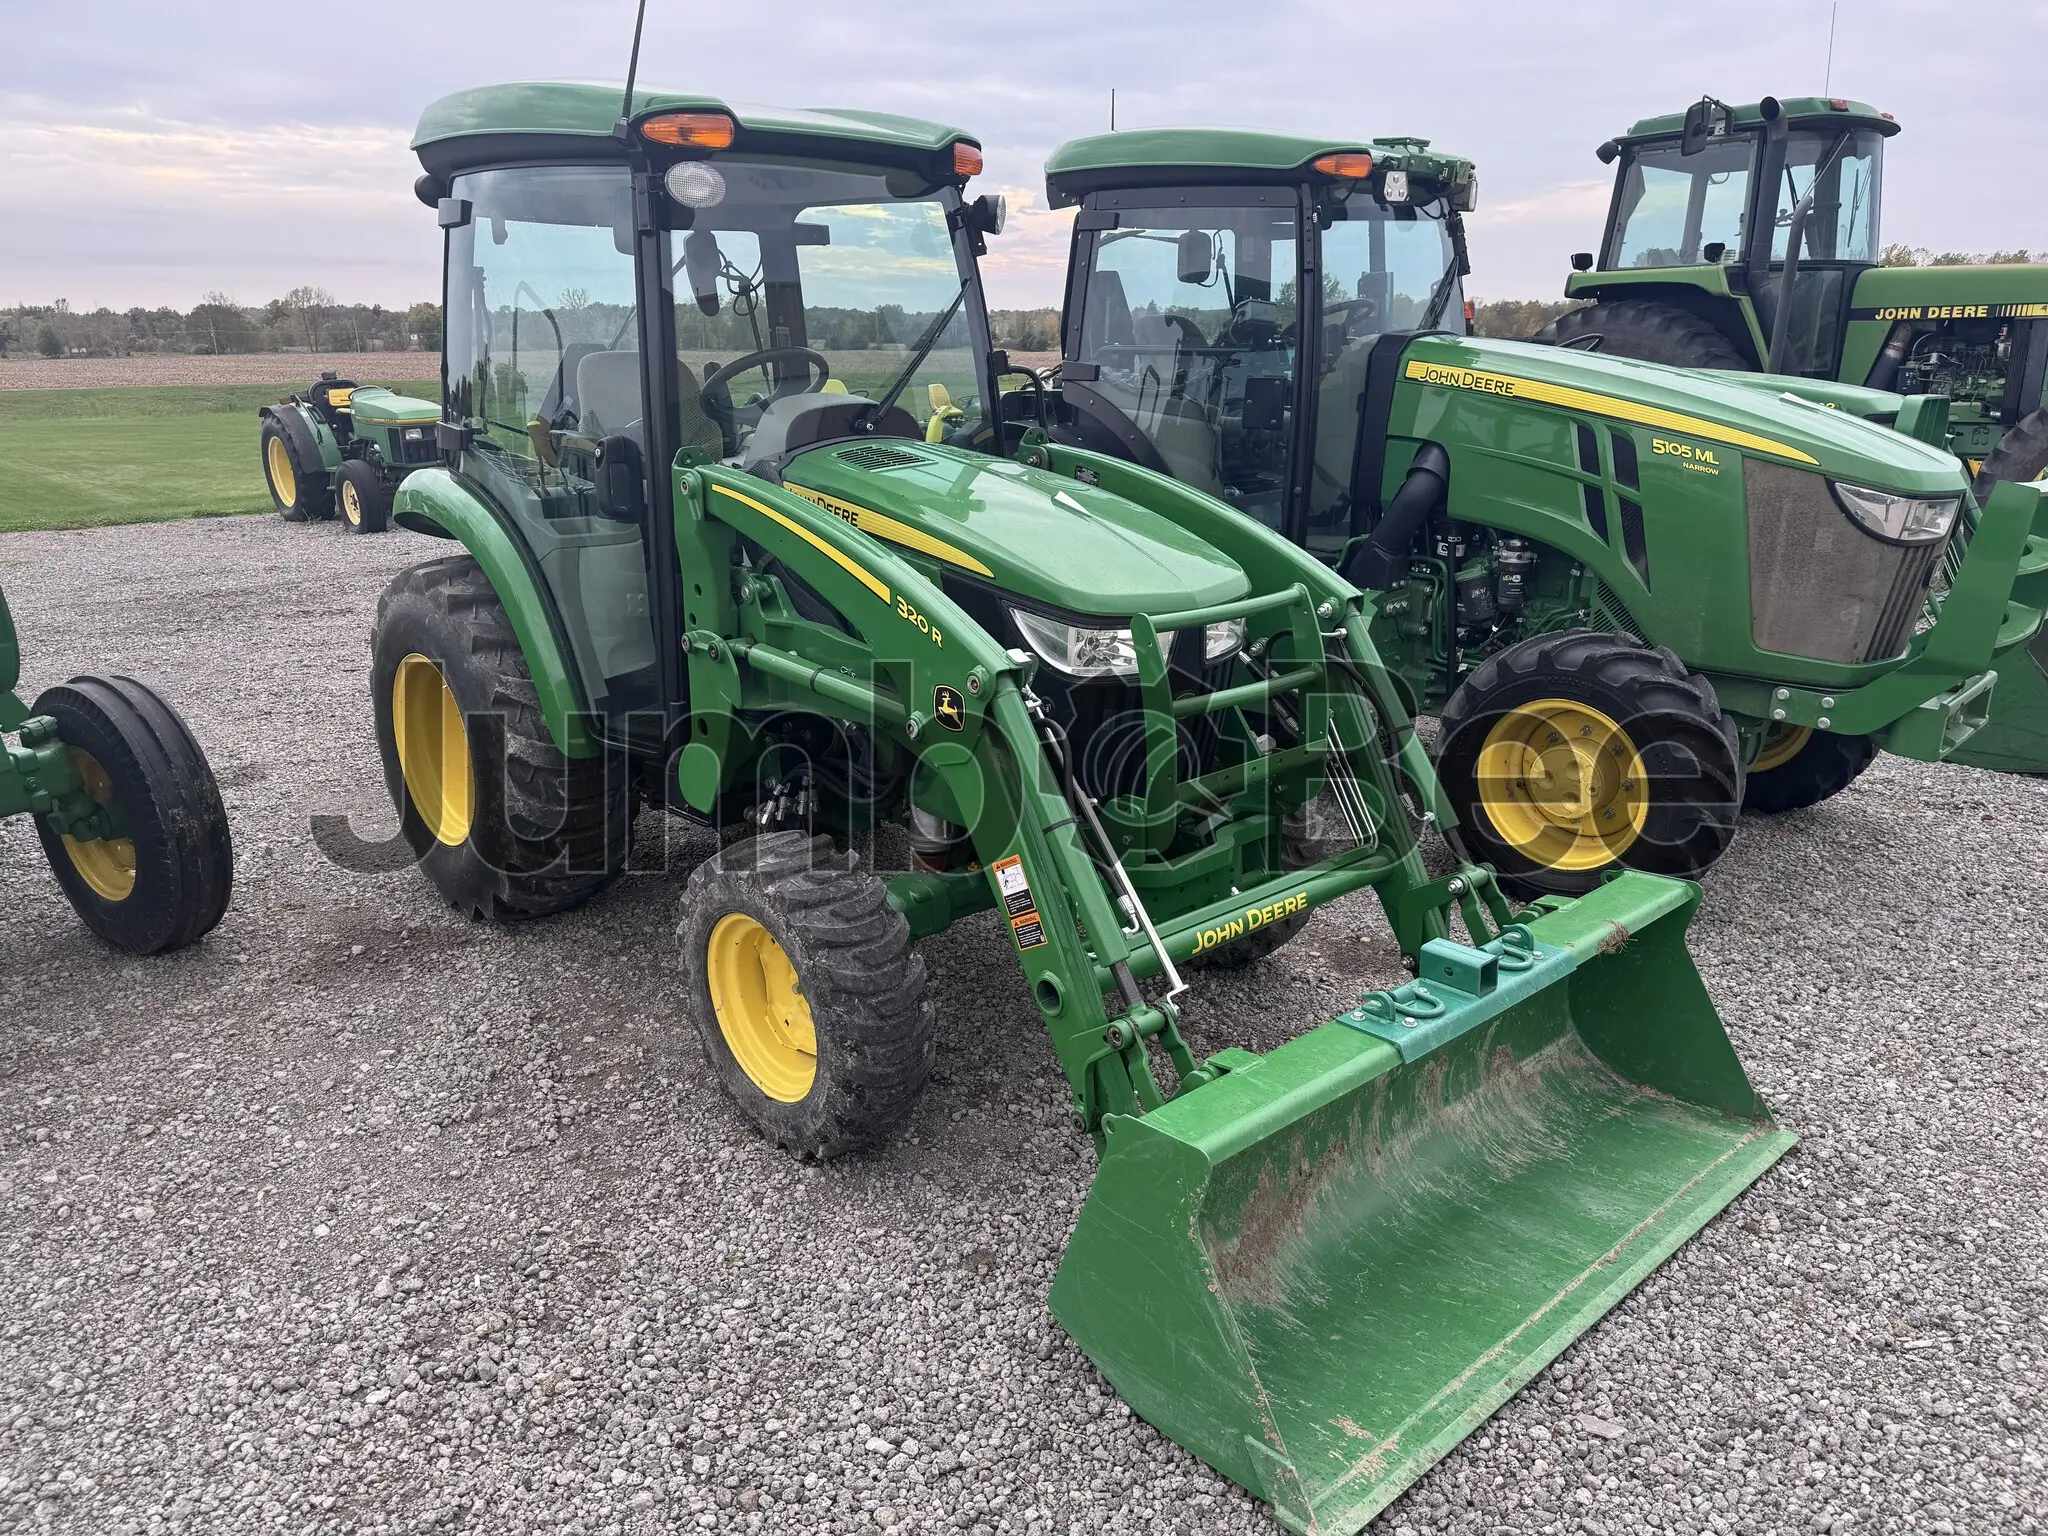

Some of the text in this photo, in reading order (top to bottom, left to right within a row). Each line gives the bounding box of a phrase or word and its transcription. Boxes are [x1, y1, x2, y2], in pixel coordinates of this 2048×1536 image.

[1875, 305, 1989, 320] JOHN DEERE
[1419, 366, 1516, 395] JOHN DEERE
[1652, 438, 1720, 466] 5105 ML
[1682, 461, 1720, 476] NARROW
[896, 594, 944, 650] 320 R
[1191, 891, 1309, 955] JOHN DEERE
